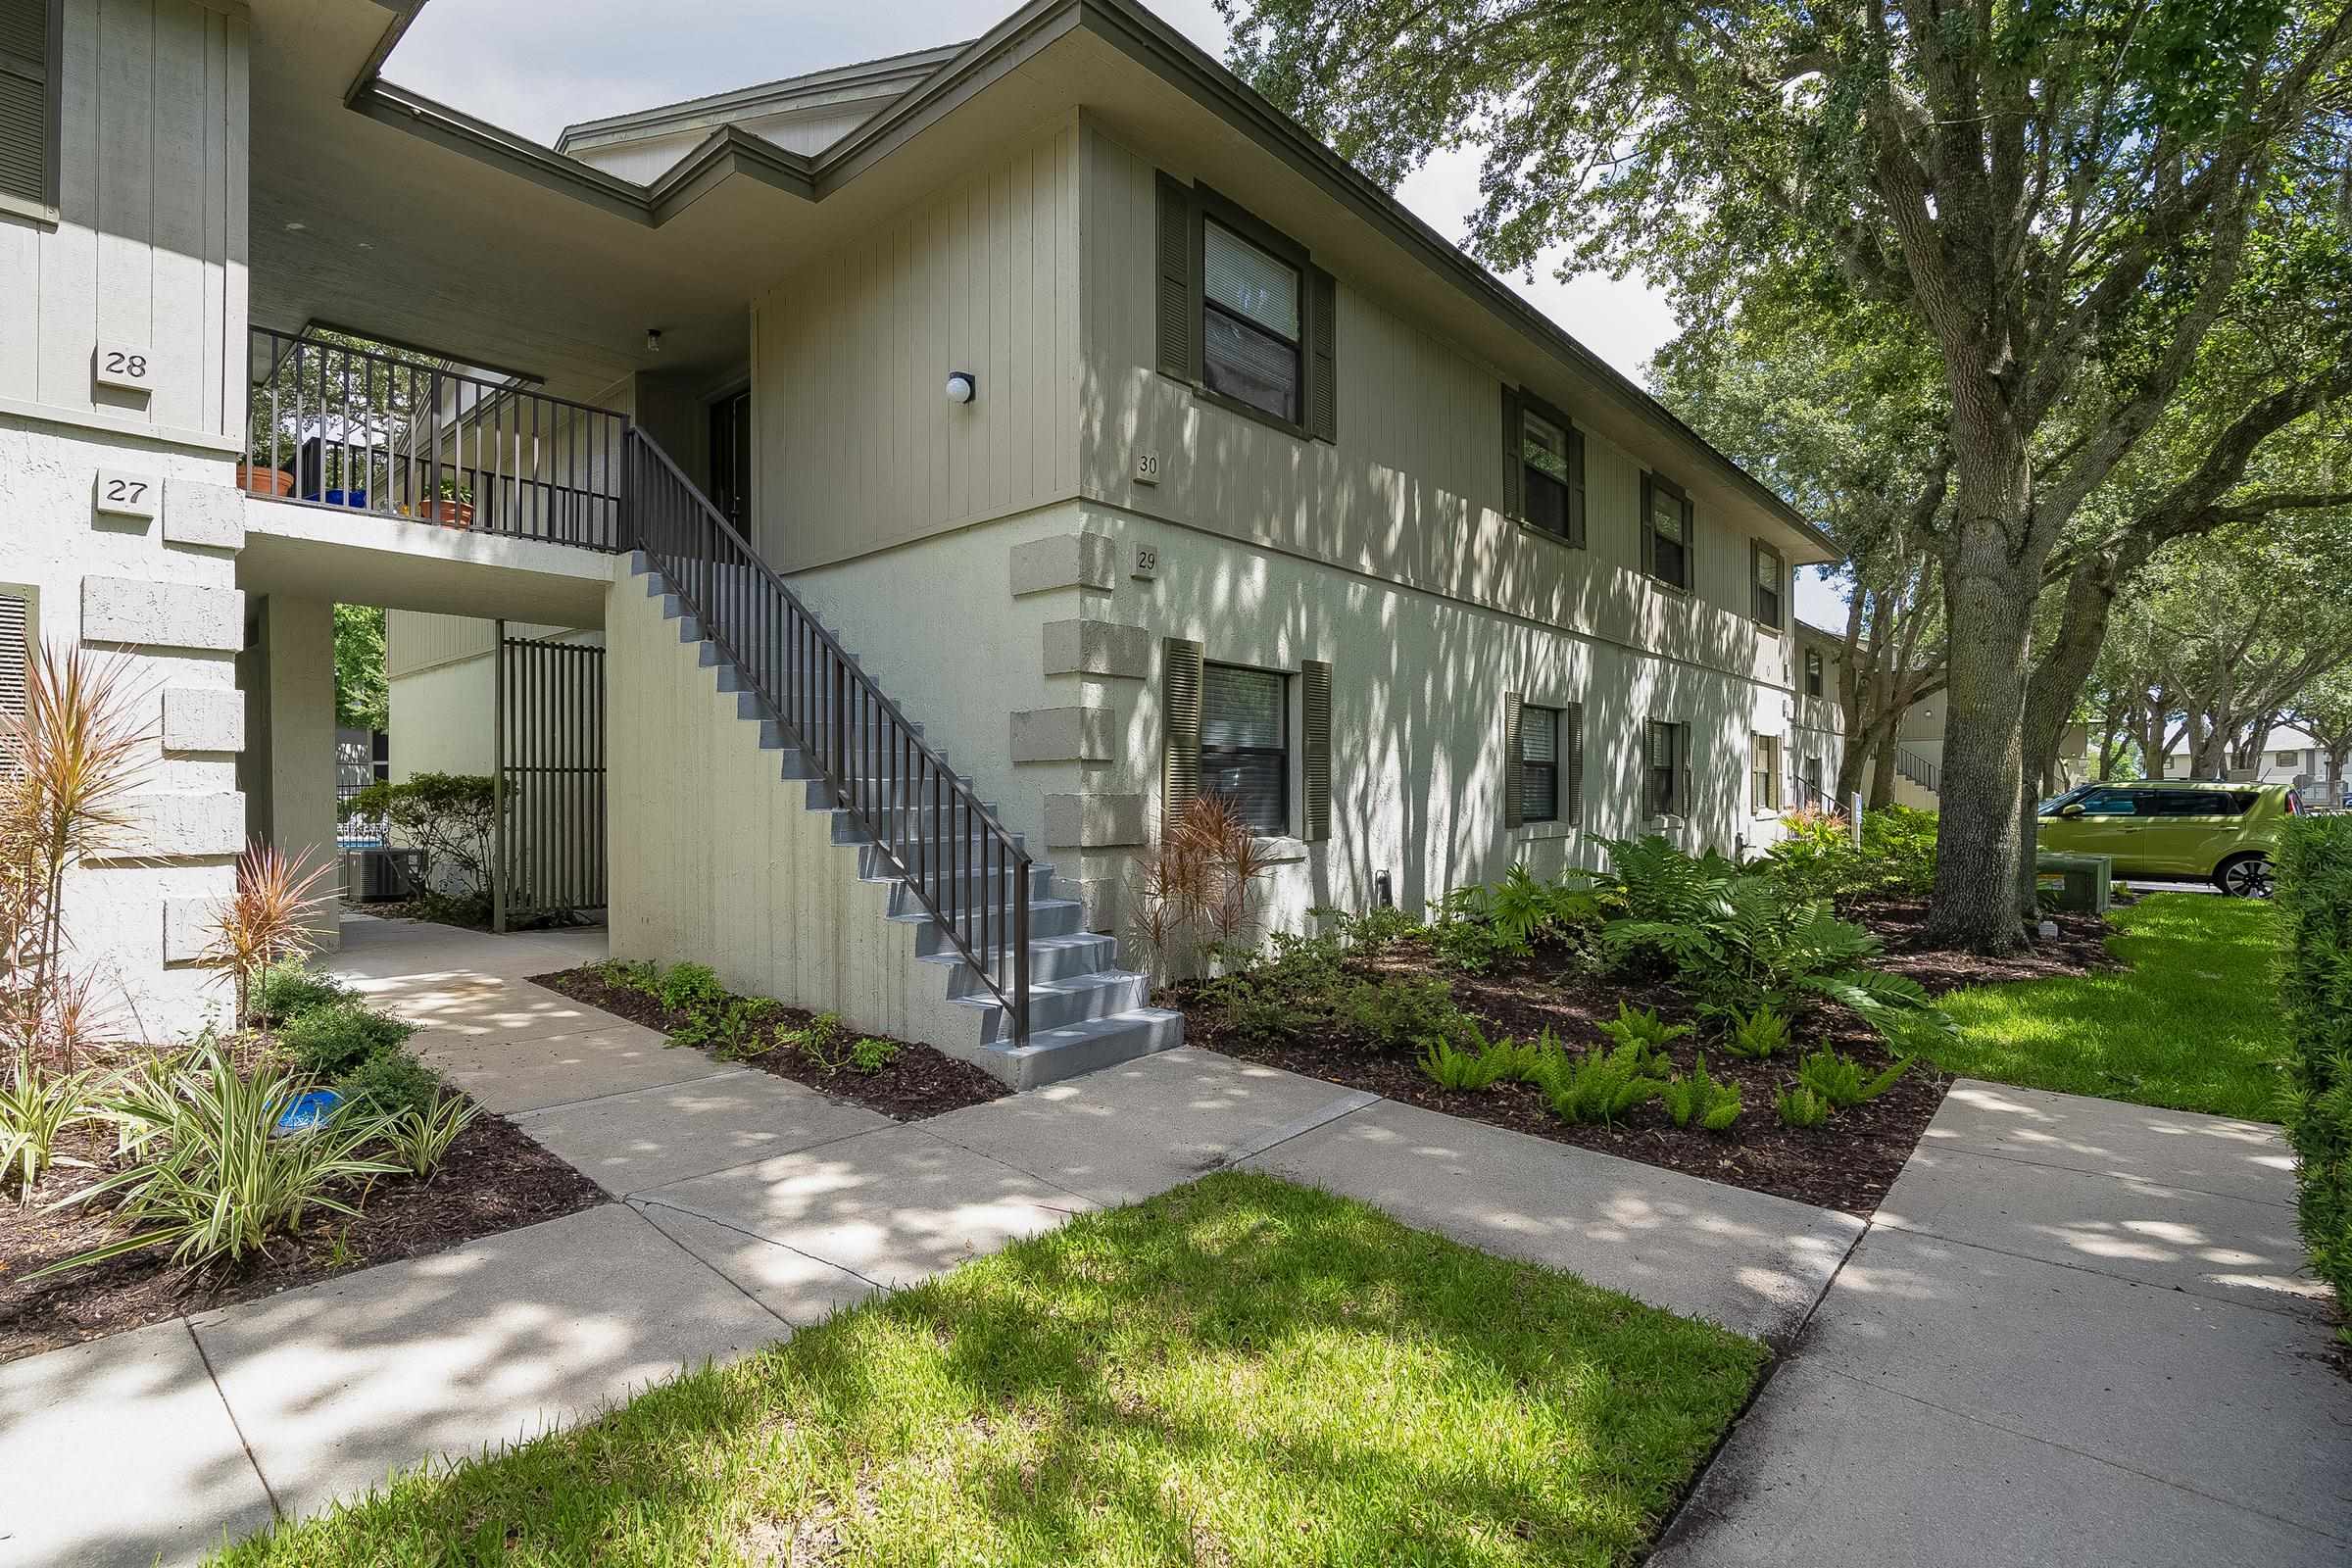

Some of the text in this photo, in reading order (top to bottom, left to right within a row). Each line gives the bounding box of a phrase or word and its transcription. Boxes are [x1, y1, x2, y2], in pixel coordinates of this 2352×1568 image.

[106, 352, 146, 378] 28
[1140, 456, 1156, 474] 30
[107, 479, 148, 504] 27
[1139, 552, 1155, 570] 29
